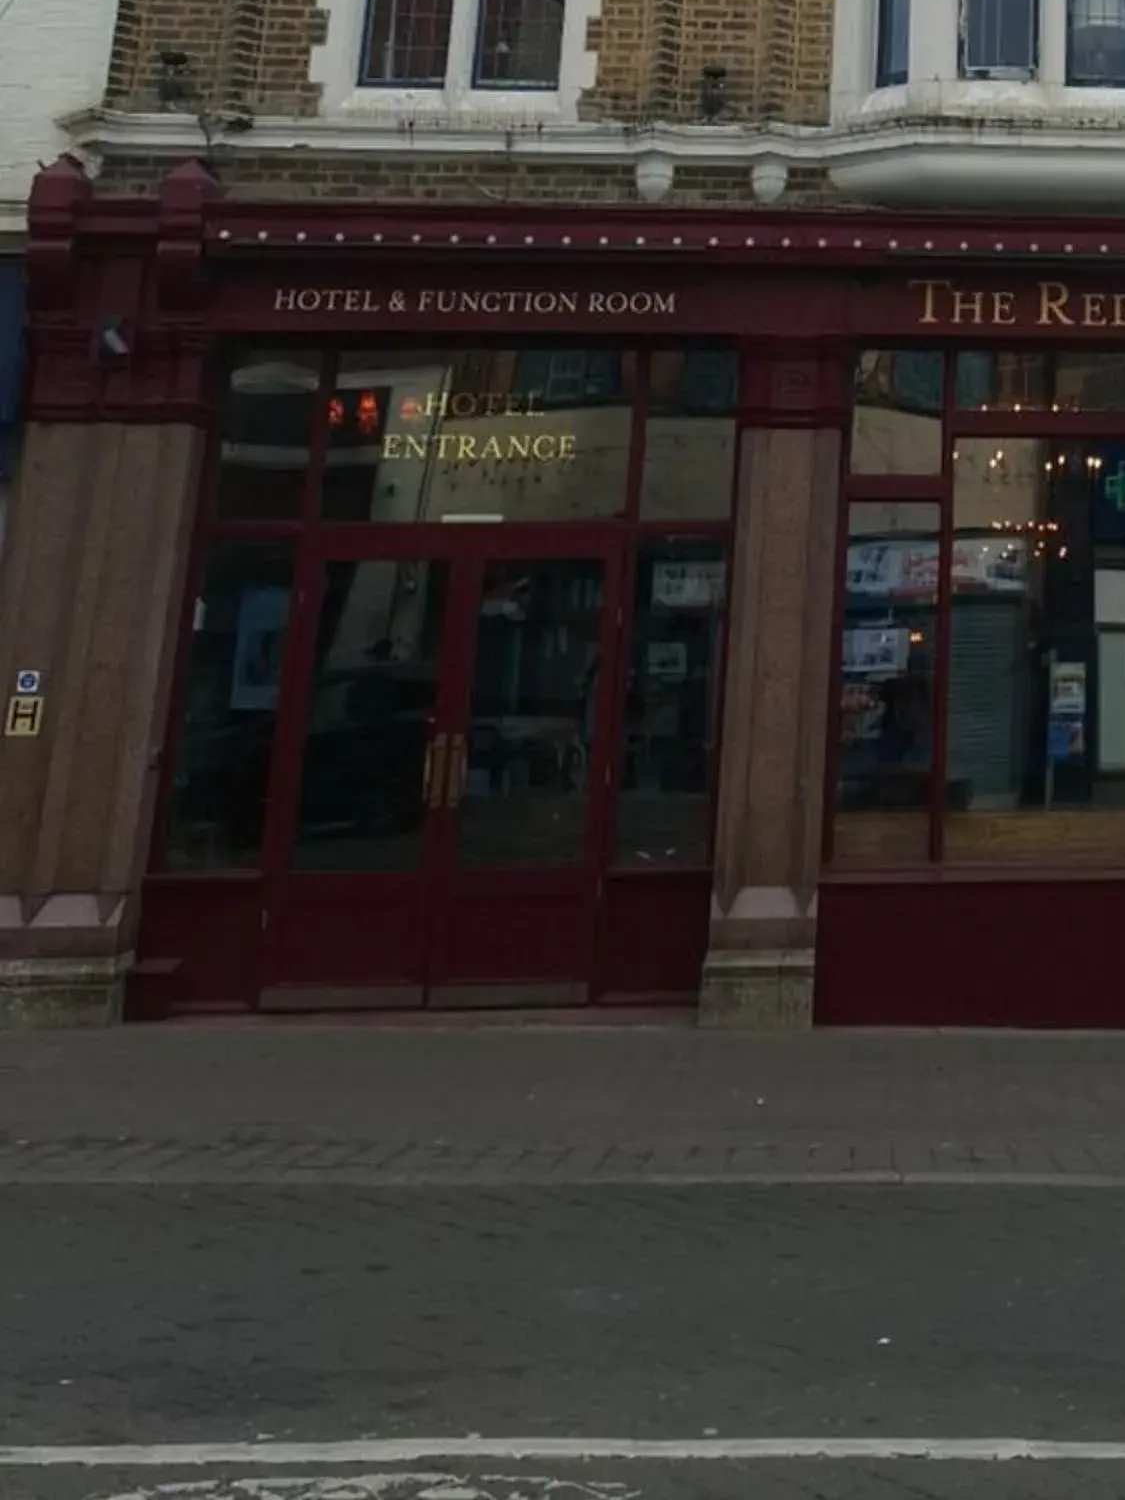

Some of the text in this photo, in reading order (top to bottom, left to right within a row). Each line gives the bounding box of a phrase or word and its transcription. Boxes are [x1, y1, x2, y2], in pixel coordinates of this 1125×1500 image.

[273, 288, 678, 315] HOTEL & FUNCTION ROOM
[424, 391, 546, 417] HOTEL
[382, 433, 577, 461] ENTRANCE
